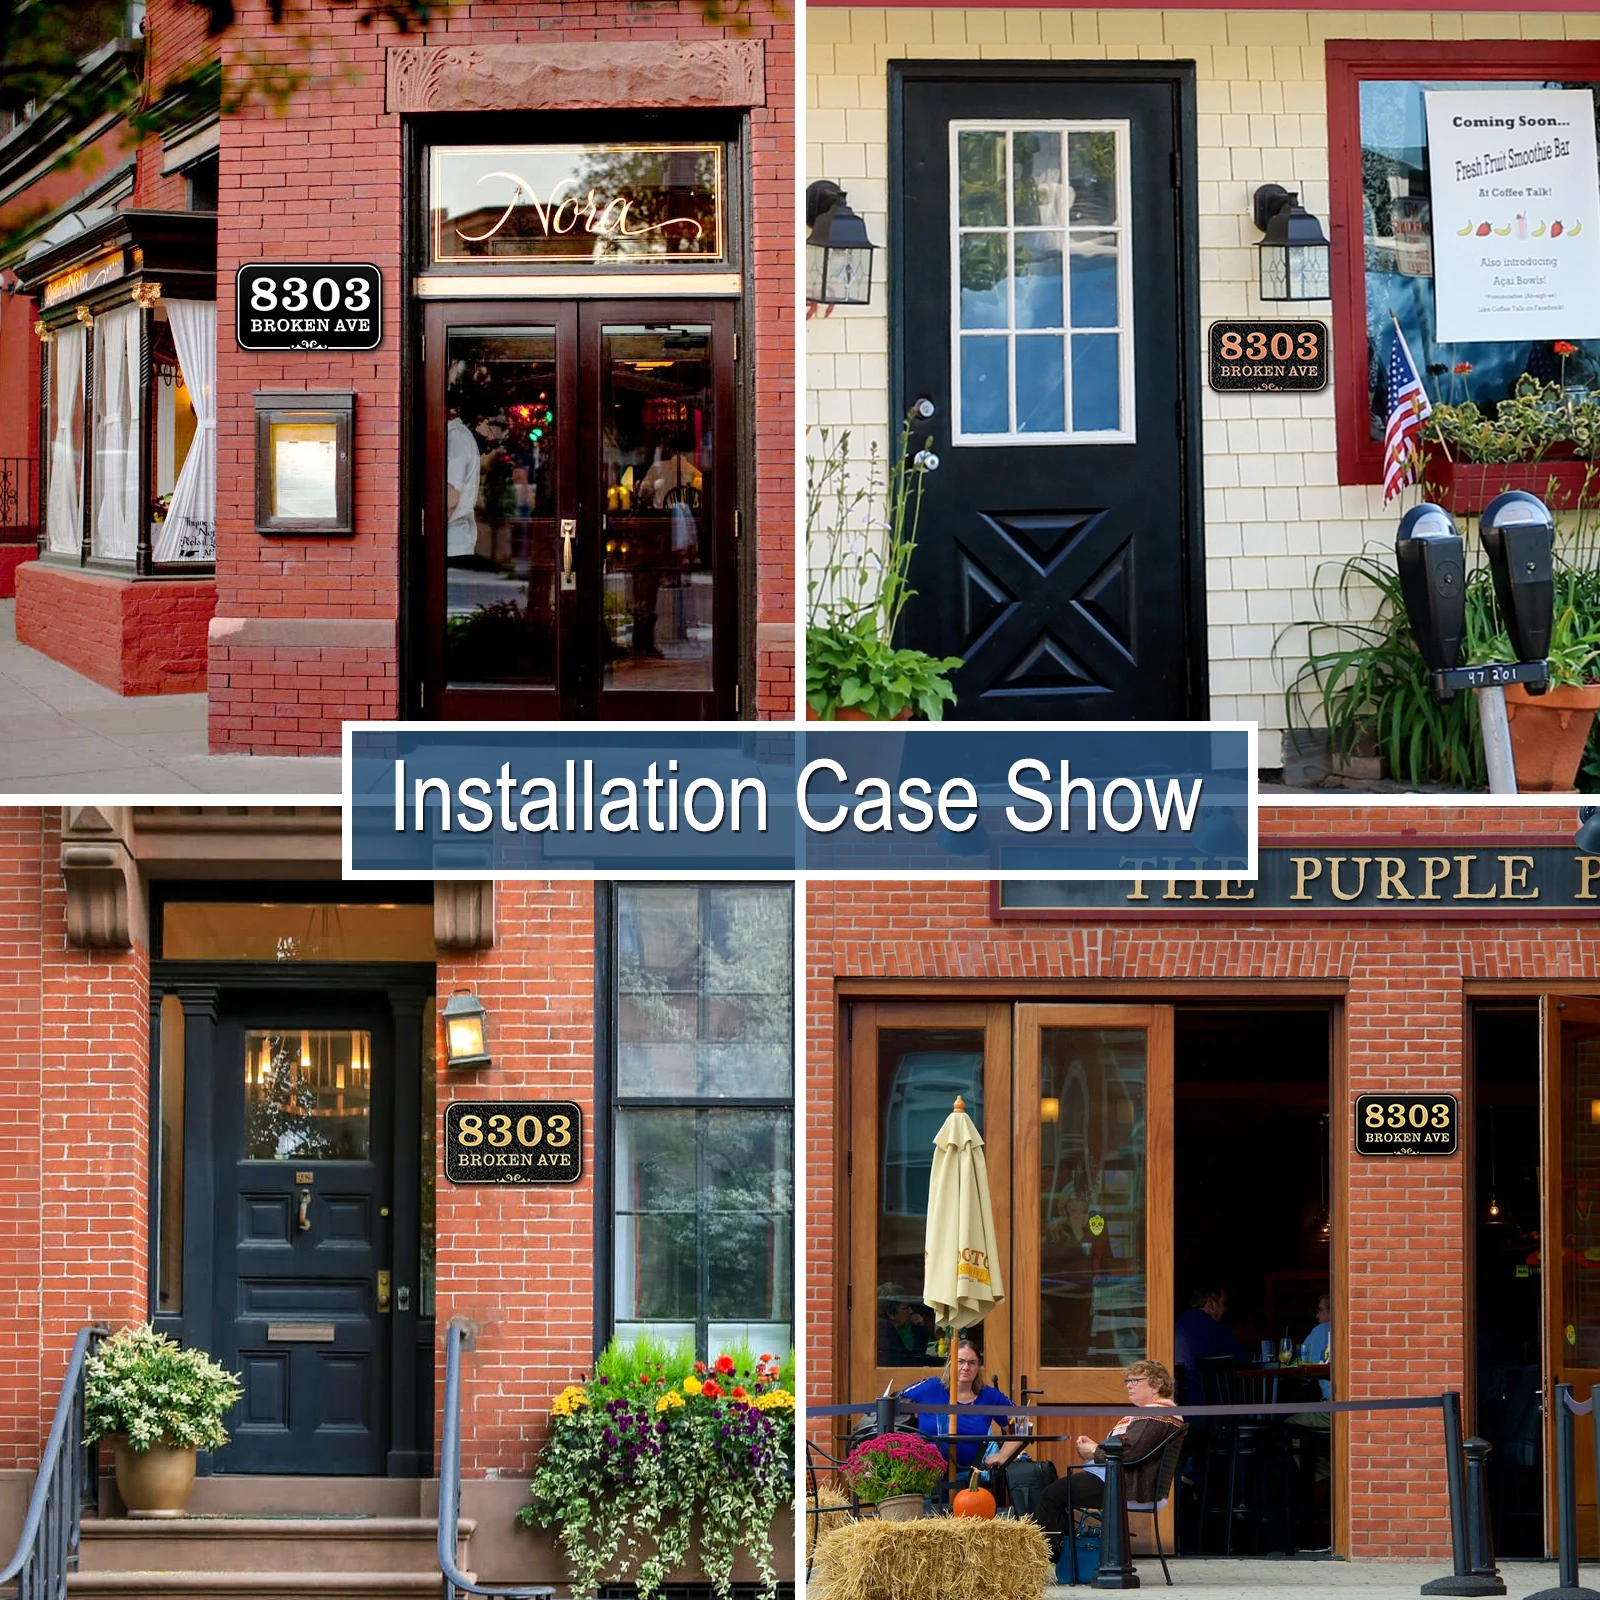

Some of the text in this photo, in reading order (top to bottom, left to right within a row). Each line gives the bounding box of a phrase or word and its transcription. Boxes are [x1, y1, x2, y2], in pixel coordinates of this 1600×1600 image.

[1452, 115, 1570, 130] Coming Soon...
[1455, 137, 1571, 182] Fresh Fruit Smoothie Bar
[1478, 186, 1553, 198] At Coffee Talk!
[455, 171, 703, 242] Nora
[1480, 256, 1558, 268] Also introducing
[1516, 275, 1547, 286] Bowls!
[251, 277, 371, 312] 8303
[250, 318, 371, 332] BROKEN AVE
[1221, 332, 1318, 360] 8303
[1220, 365, 1318, 377] BROKEN AVE
[1468, 668, 1517, 685] 97 201
[1118, 855, 1256, 902] THE
[1289, 855, 1540, 901] PURPLE
[1365, 1103, 1450, 1128] 8303
[458, 1115, 572, 1147] 8303
[1365, 1132, 1450, 1143] BROKEN AVE
[458, 1153, 571, 1167] BROKEN AVE
